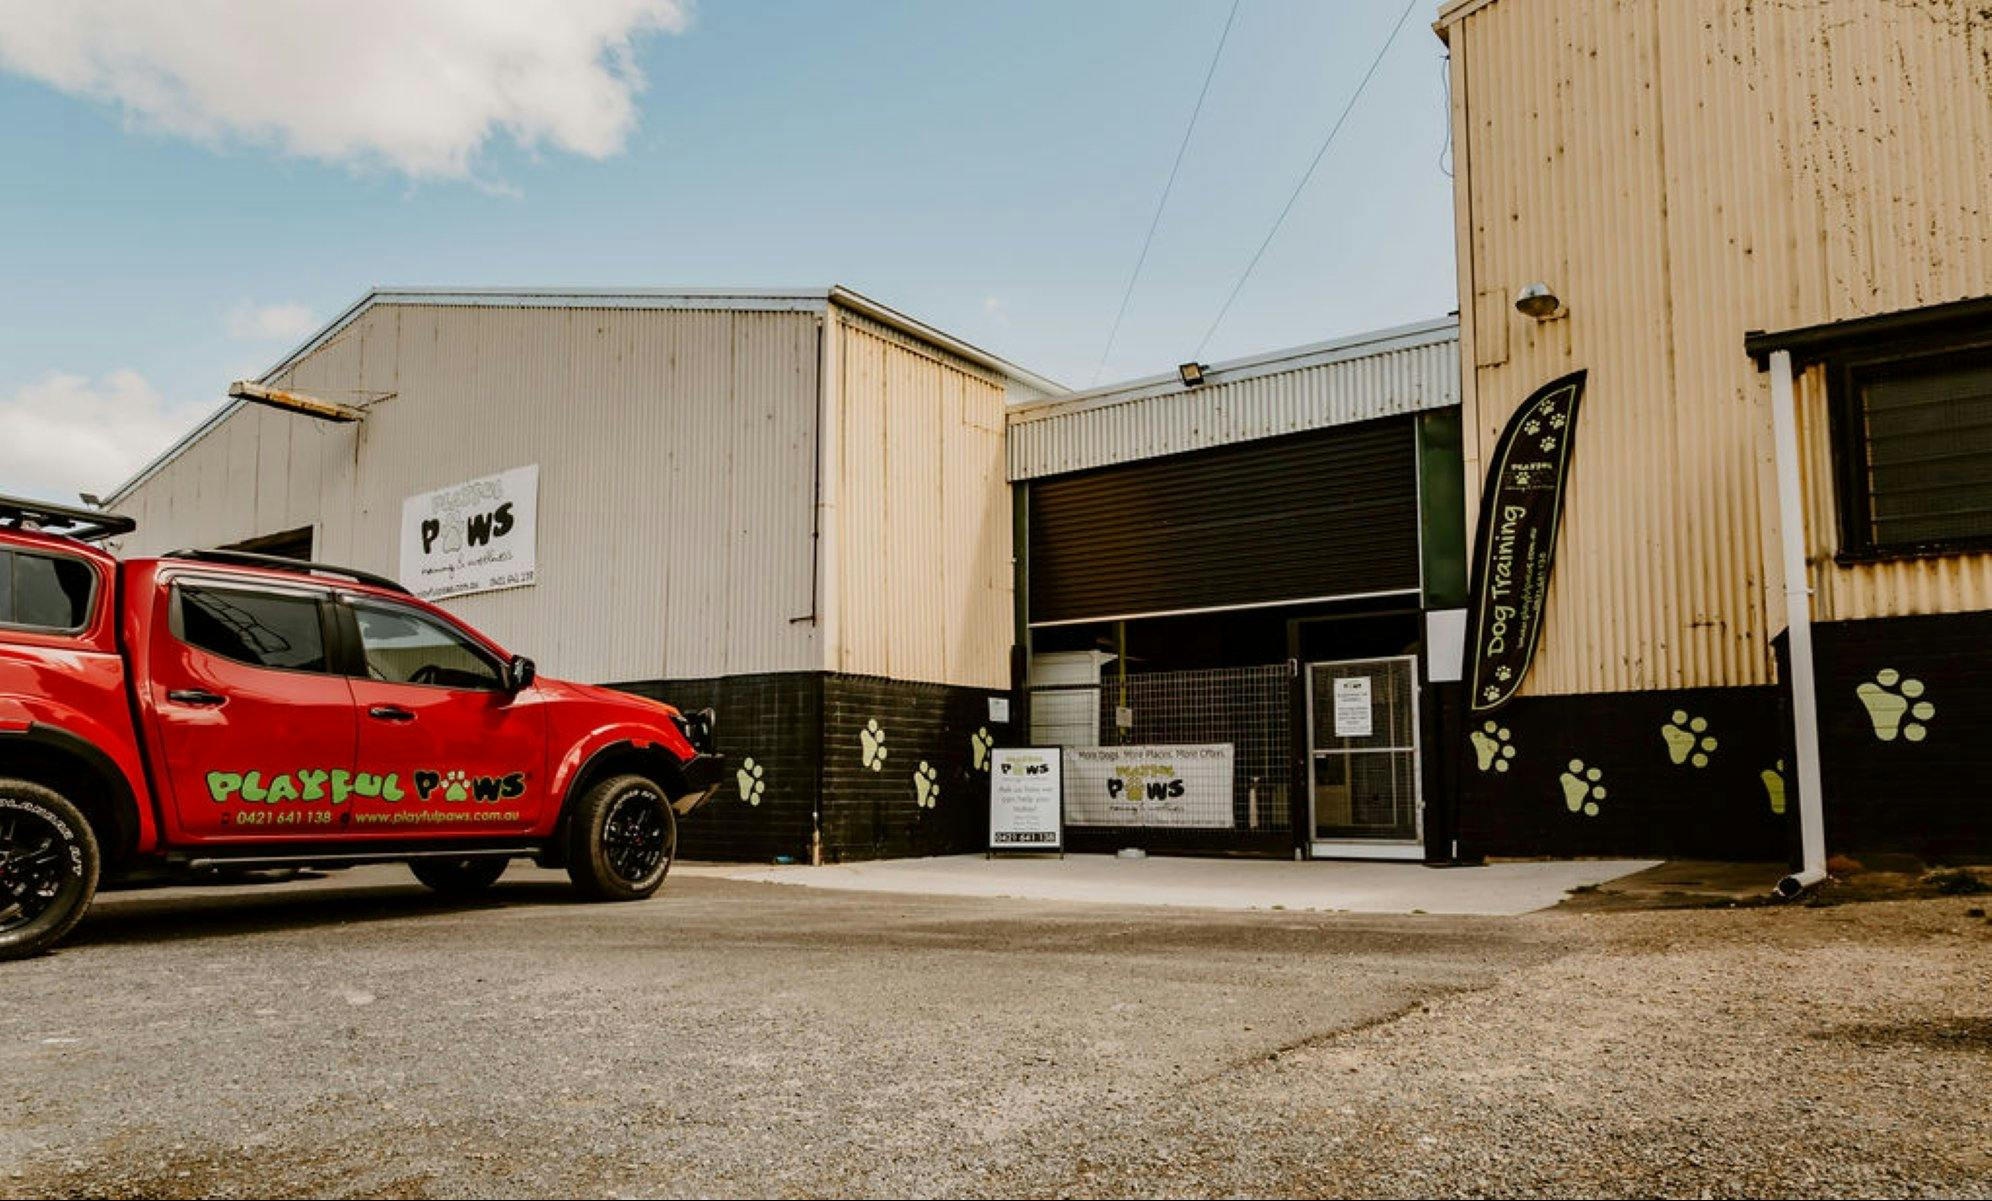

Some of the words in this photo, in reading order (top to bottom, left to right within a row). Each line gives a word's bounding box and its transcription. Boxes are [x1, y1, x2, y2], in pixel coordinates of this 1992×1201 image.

[1491, 504, 1526, 600] Training
[1487, 605, 1516, 657] Dog
[205, 769, 404, 804] PLAYFUL
[235, 810, 273, 825] 0421
[276, 810, 302, 825] 641
[307, 810, 332, 825] 138
[355, 810, 520, 825] www.playfulpaws.com.au
